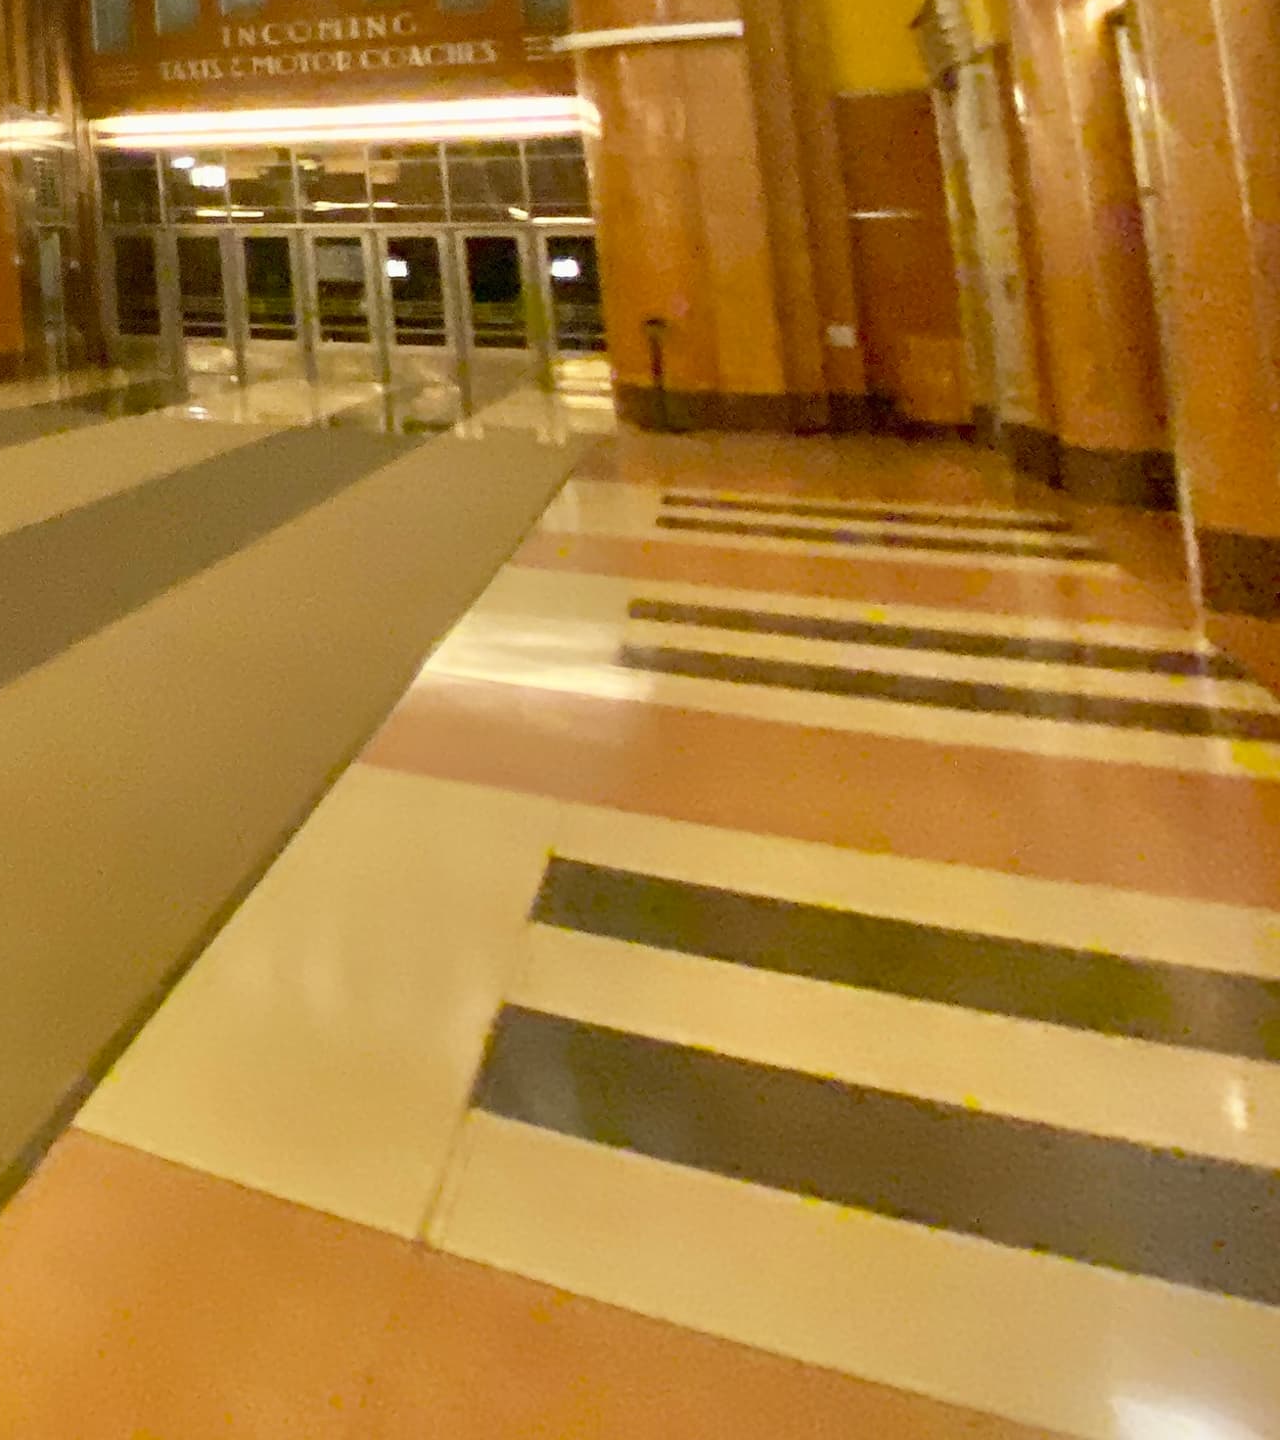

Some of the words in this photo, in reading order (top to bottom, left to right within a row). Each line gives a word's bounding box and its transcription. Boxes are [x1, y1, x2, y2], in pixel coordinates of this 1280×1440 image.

[221, 12, 418, 49] INCOMING
[159, 59, 224, 81] TAXIS
[251, 49, 353, 77] MOTOR
[359, 40, 498, 70] COACHES
